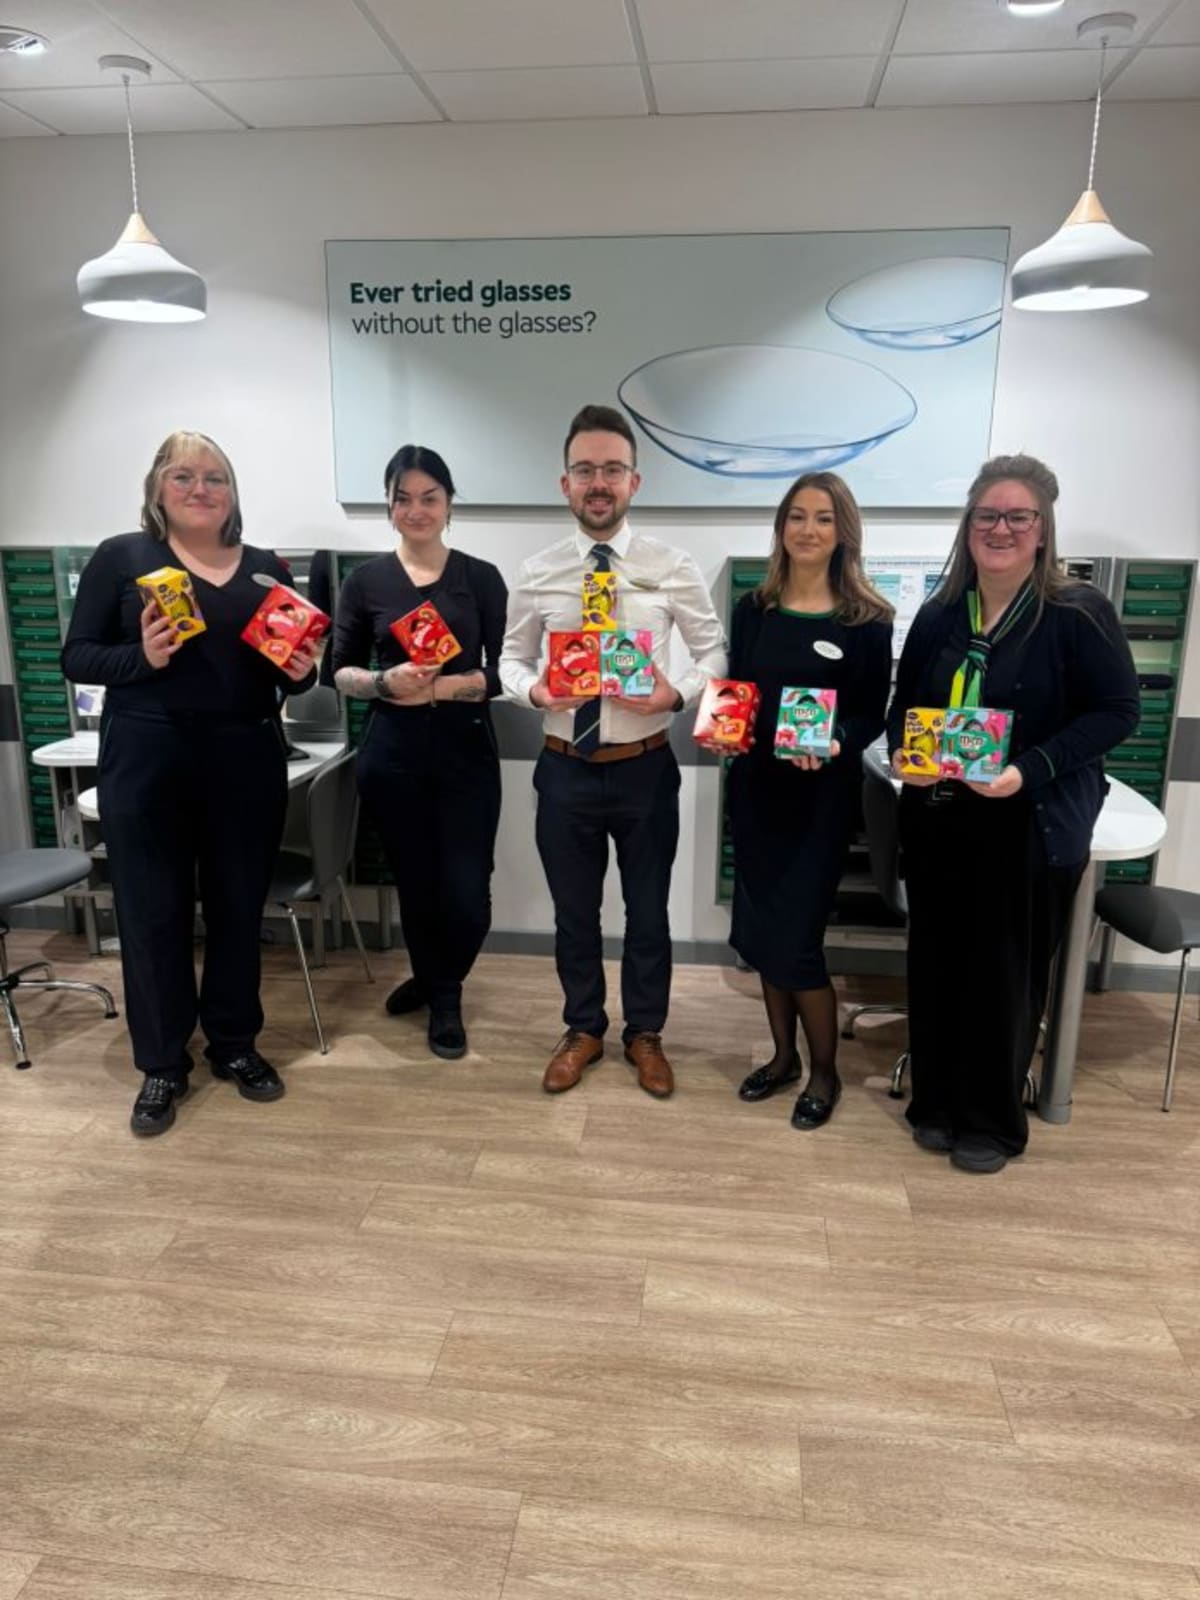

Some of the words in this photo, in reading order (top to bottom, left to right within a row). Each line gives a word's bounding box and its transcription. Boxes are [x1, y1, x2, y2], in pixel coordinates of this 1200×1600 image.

[350, 282, 404, 304] Ever
[411, 279, 473, 302] tried
[480, 279, 572, 308] glasses
[352, 312, 445, 334] without
[452, 311, 492, 333] the
[499, 310, 597, 339] glasses?
